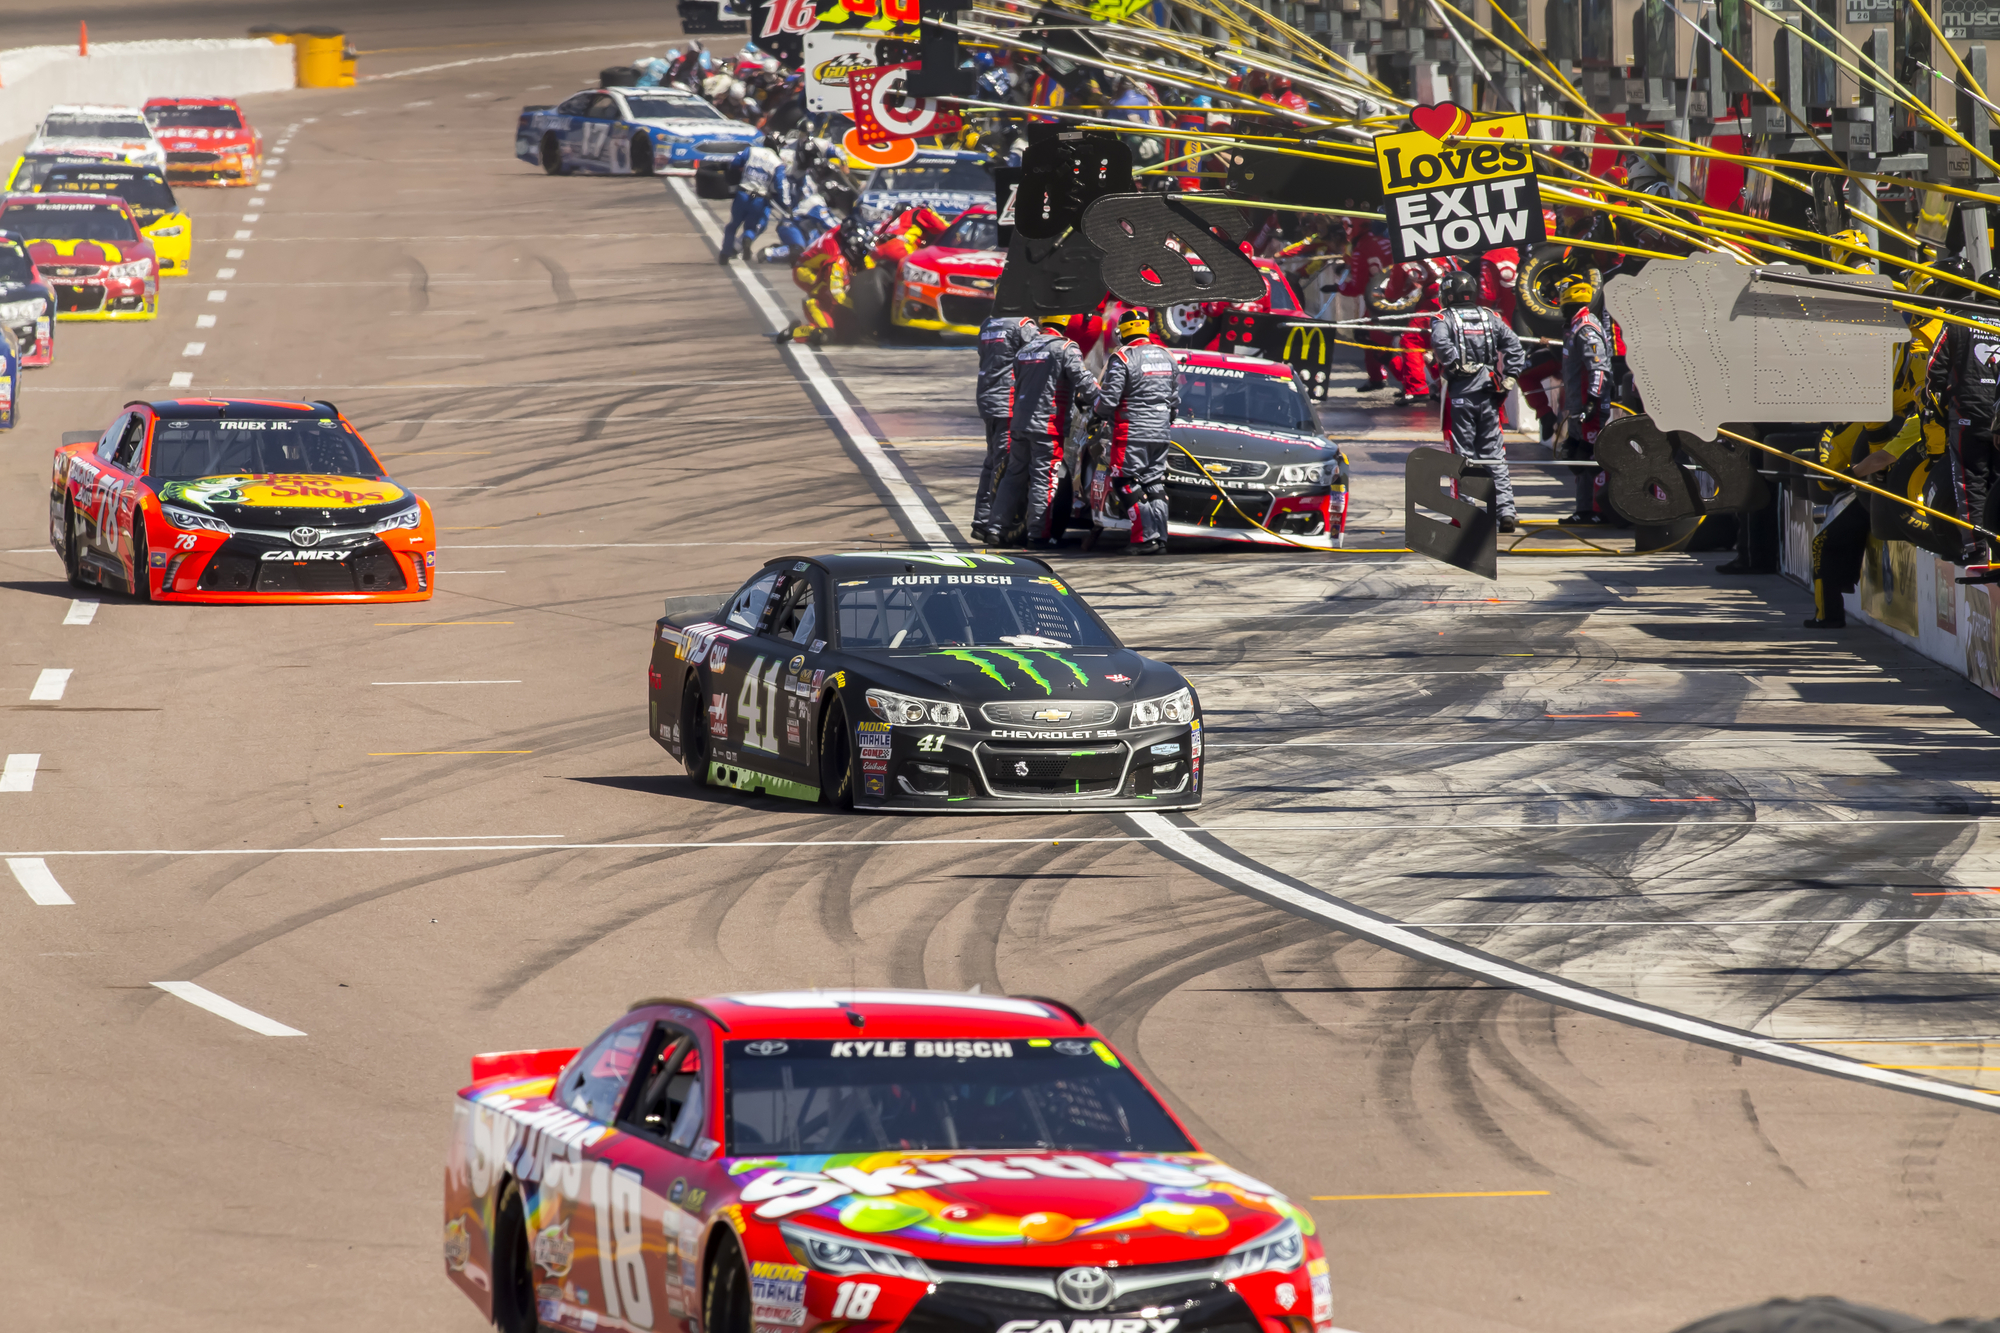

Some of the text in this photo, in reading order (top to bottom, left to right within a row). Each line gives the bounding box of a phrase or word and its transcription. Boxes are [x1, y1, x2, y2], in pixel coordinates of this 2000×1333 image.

[760, 0, 819, 38] 16
[1858, 12, 1868, 20] 26
[582, 122, 609, 157] 17
[1396, 178, 1526, 226] EXIT
[1401, 209, 1529, 258] NOW
[1518, 257, 1547, 316] GOODYEAR
[1178, 364, 1245, 379] NEWMAN
[220, 421, 292, 430] TRUEX JR.
[271, 485, 384, 505] Shops
[96, 474, 124, 553] 78
[173, 533, 198, 549] 78
[261, 550, 351, 561] CAMRY
[892, 575, 1012, 586] KURT BUSCH
[737, 655, 783, 755] 41
[858, 721, 892, 733] MOOG
[991, 729, 1117, 740] CHEVROLET SS
[860, 734, 890, 745] MAHLE
[917, 734, 944, 752] 41
[862, 748, 884, 757] COMP
[863, 761, 887, 771] Edelbrock
[831, 1041, 1014, 1058] KYLE BUSCH
[591, 1160, 654, 1332] 18
[751, 1262, 809, 1282] MOOG
[754, 1283, 804, 1301] MAHLE
[831, 1281, 881, 1320] 18
